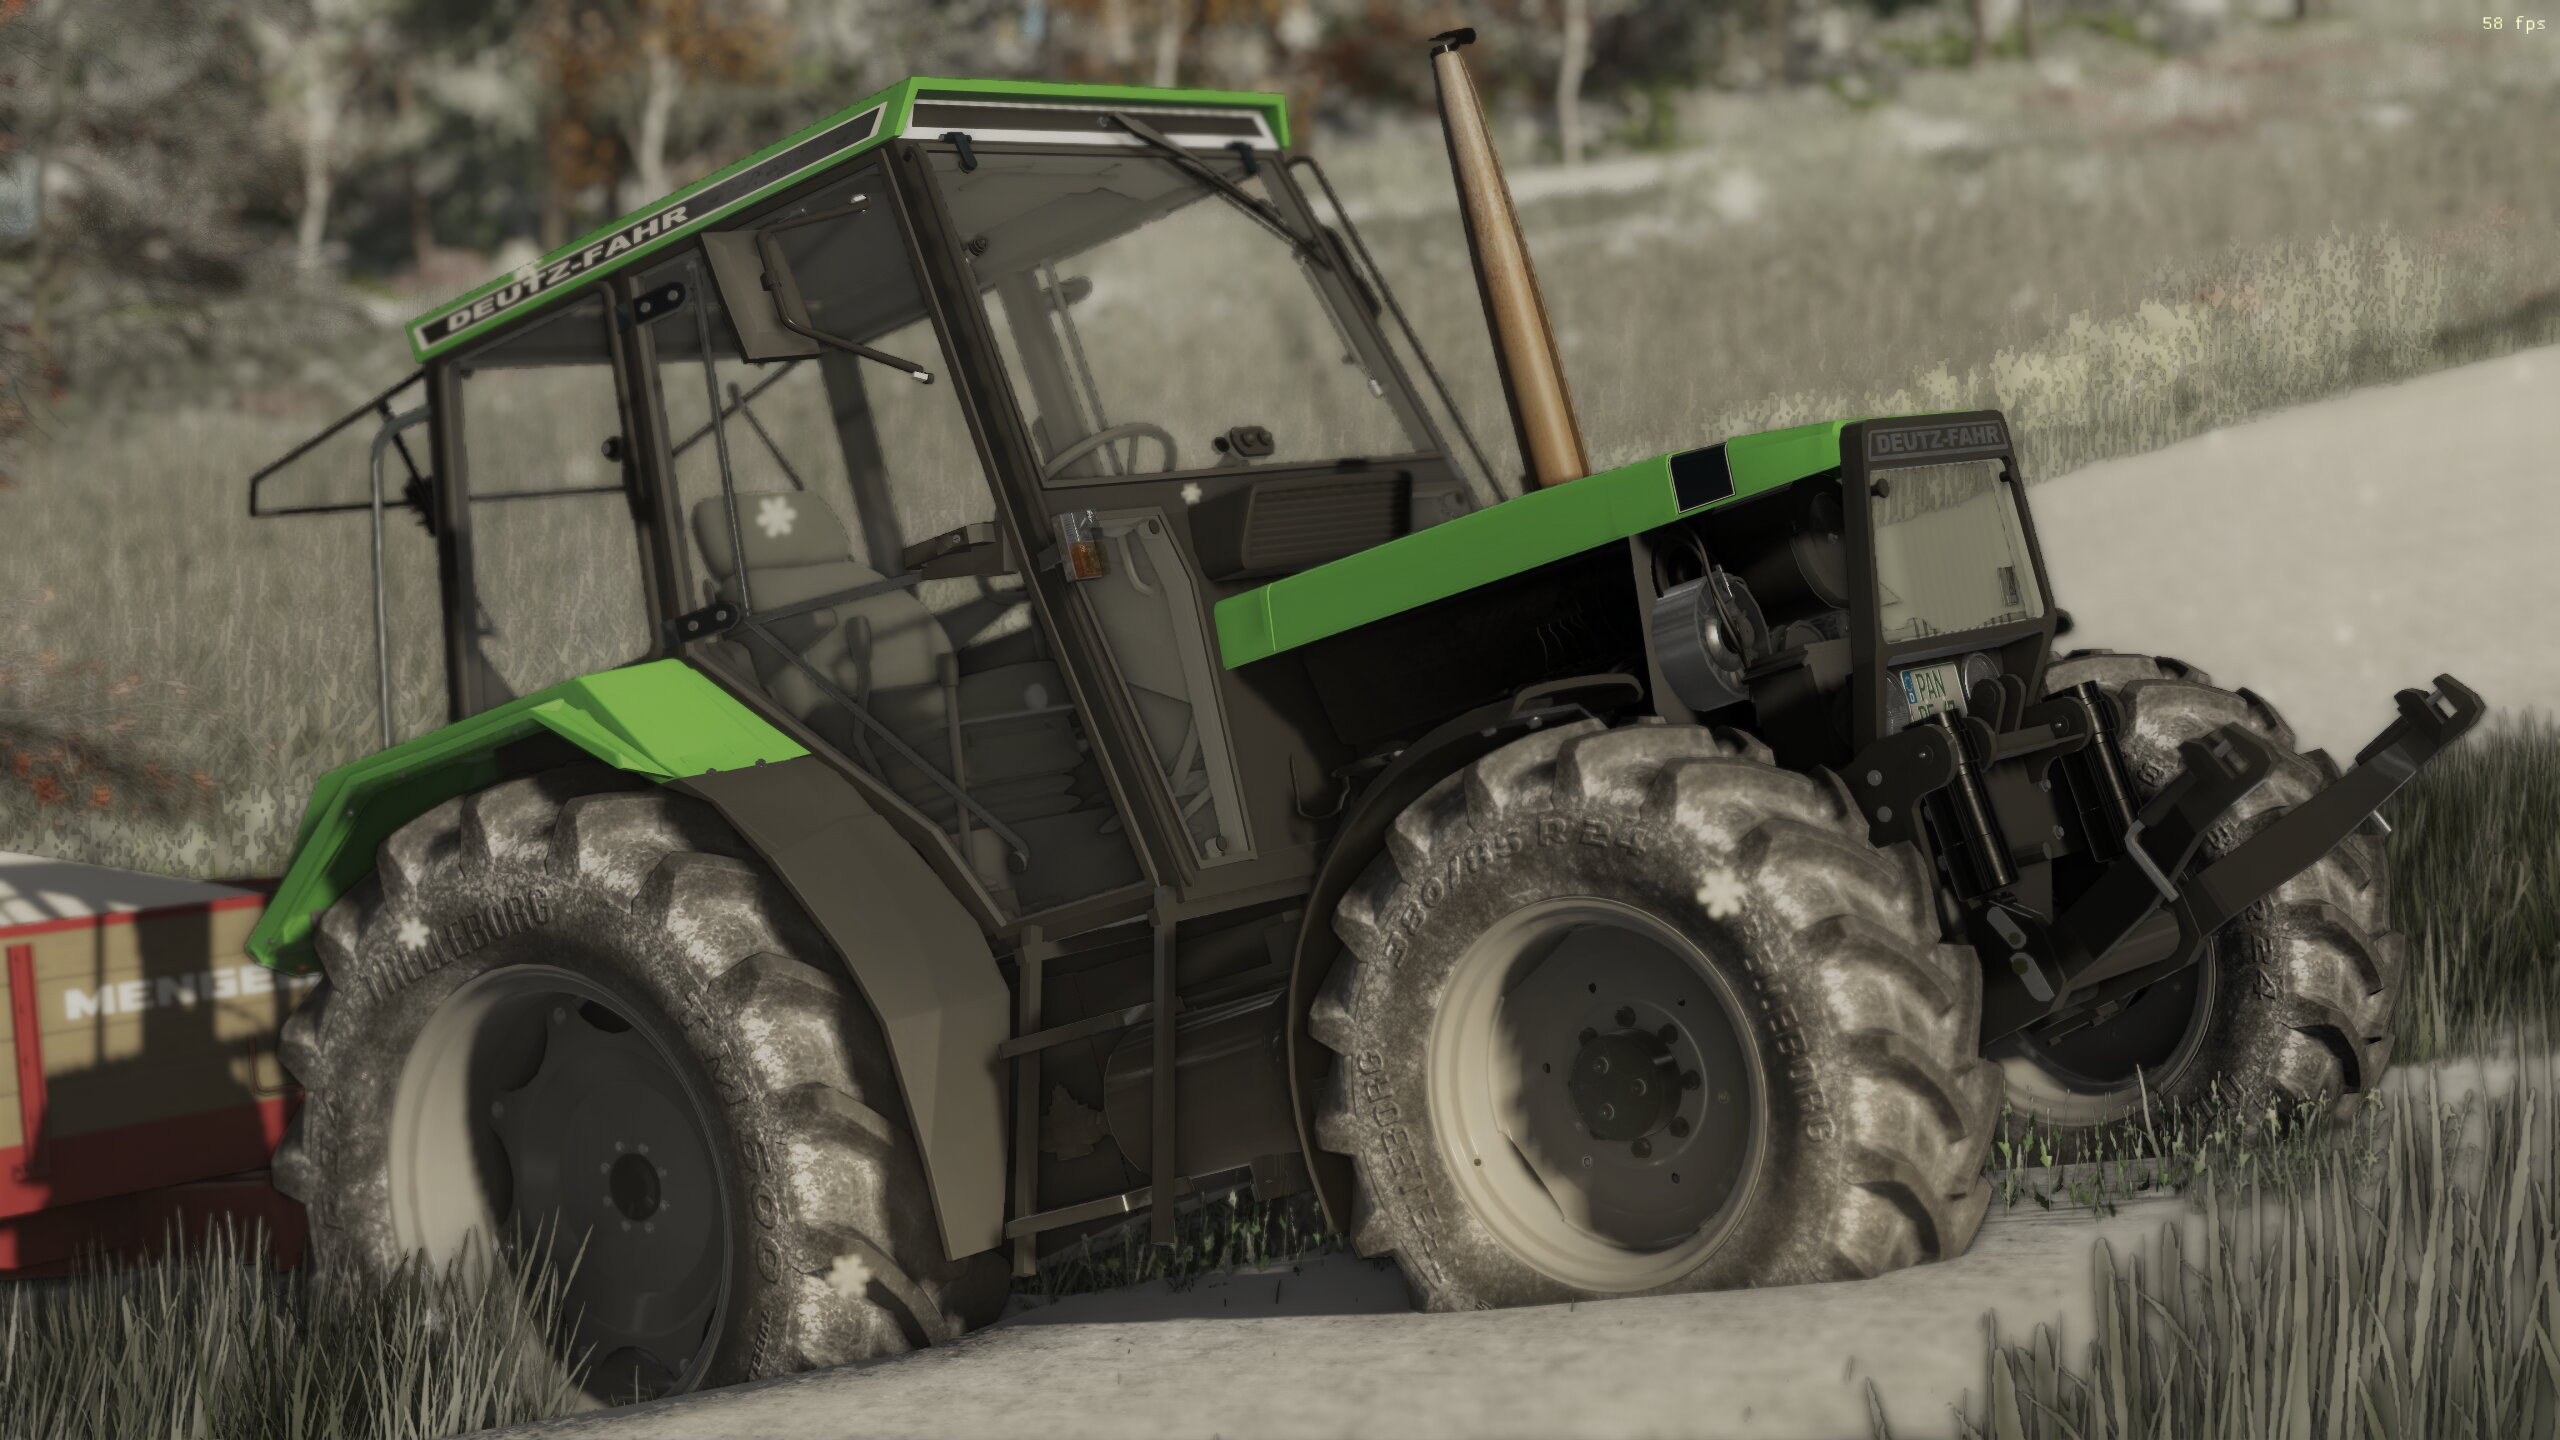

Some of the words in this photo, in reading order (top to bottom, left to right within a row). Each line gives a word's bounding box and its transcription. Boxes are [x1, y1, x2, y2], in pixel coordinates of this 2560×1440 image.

[446, 206, 690, 332] DEUTZ-FAHR
[1876, 425, 2002, 454] DEUTZ-FAHR
[1915, 669, 1947, 702] PAN
[64, 965, 322, 1021] MENGE
